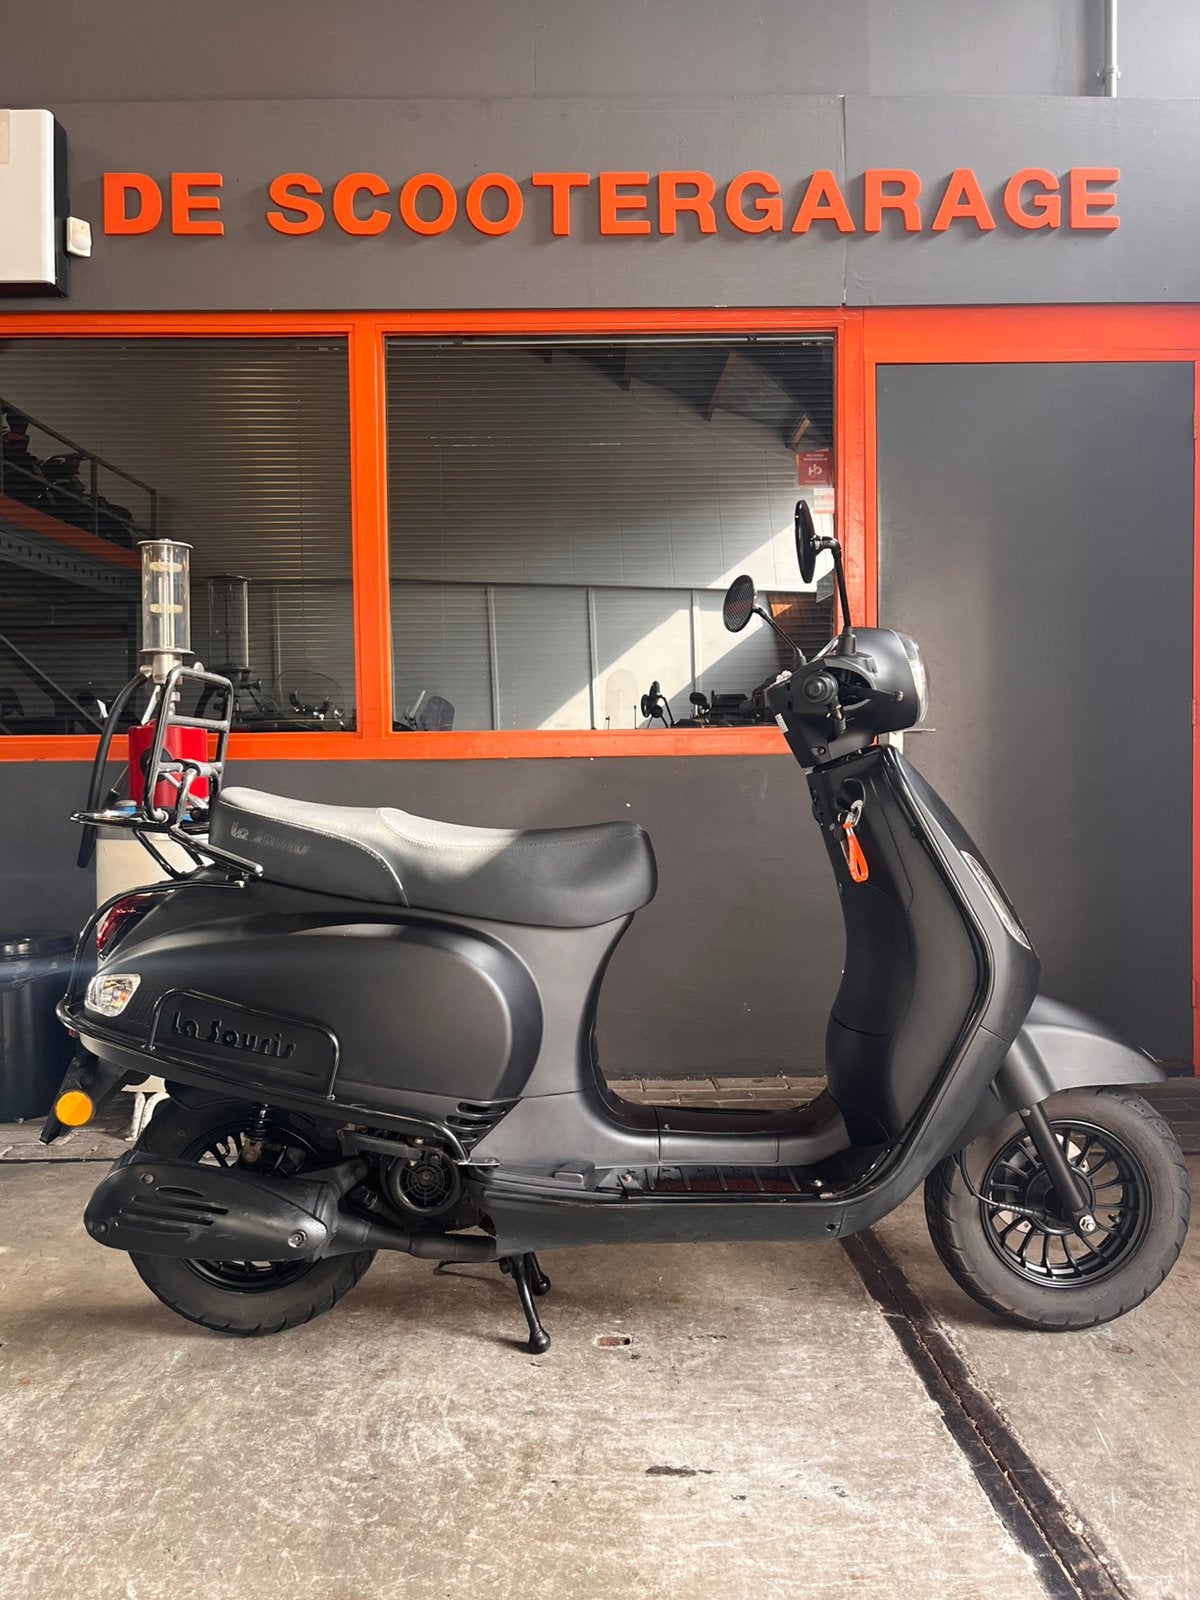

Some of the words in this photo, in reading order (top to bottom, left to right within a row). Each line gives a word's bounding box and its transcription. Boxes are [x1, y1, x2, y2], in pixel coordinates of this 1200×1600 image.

[103, 172, 224, 235] DE
[267, 167, 1122, 237] SCOOTERGARAGE
[207, 1020, 297, 1059] Souris
